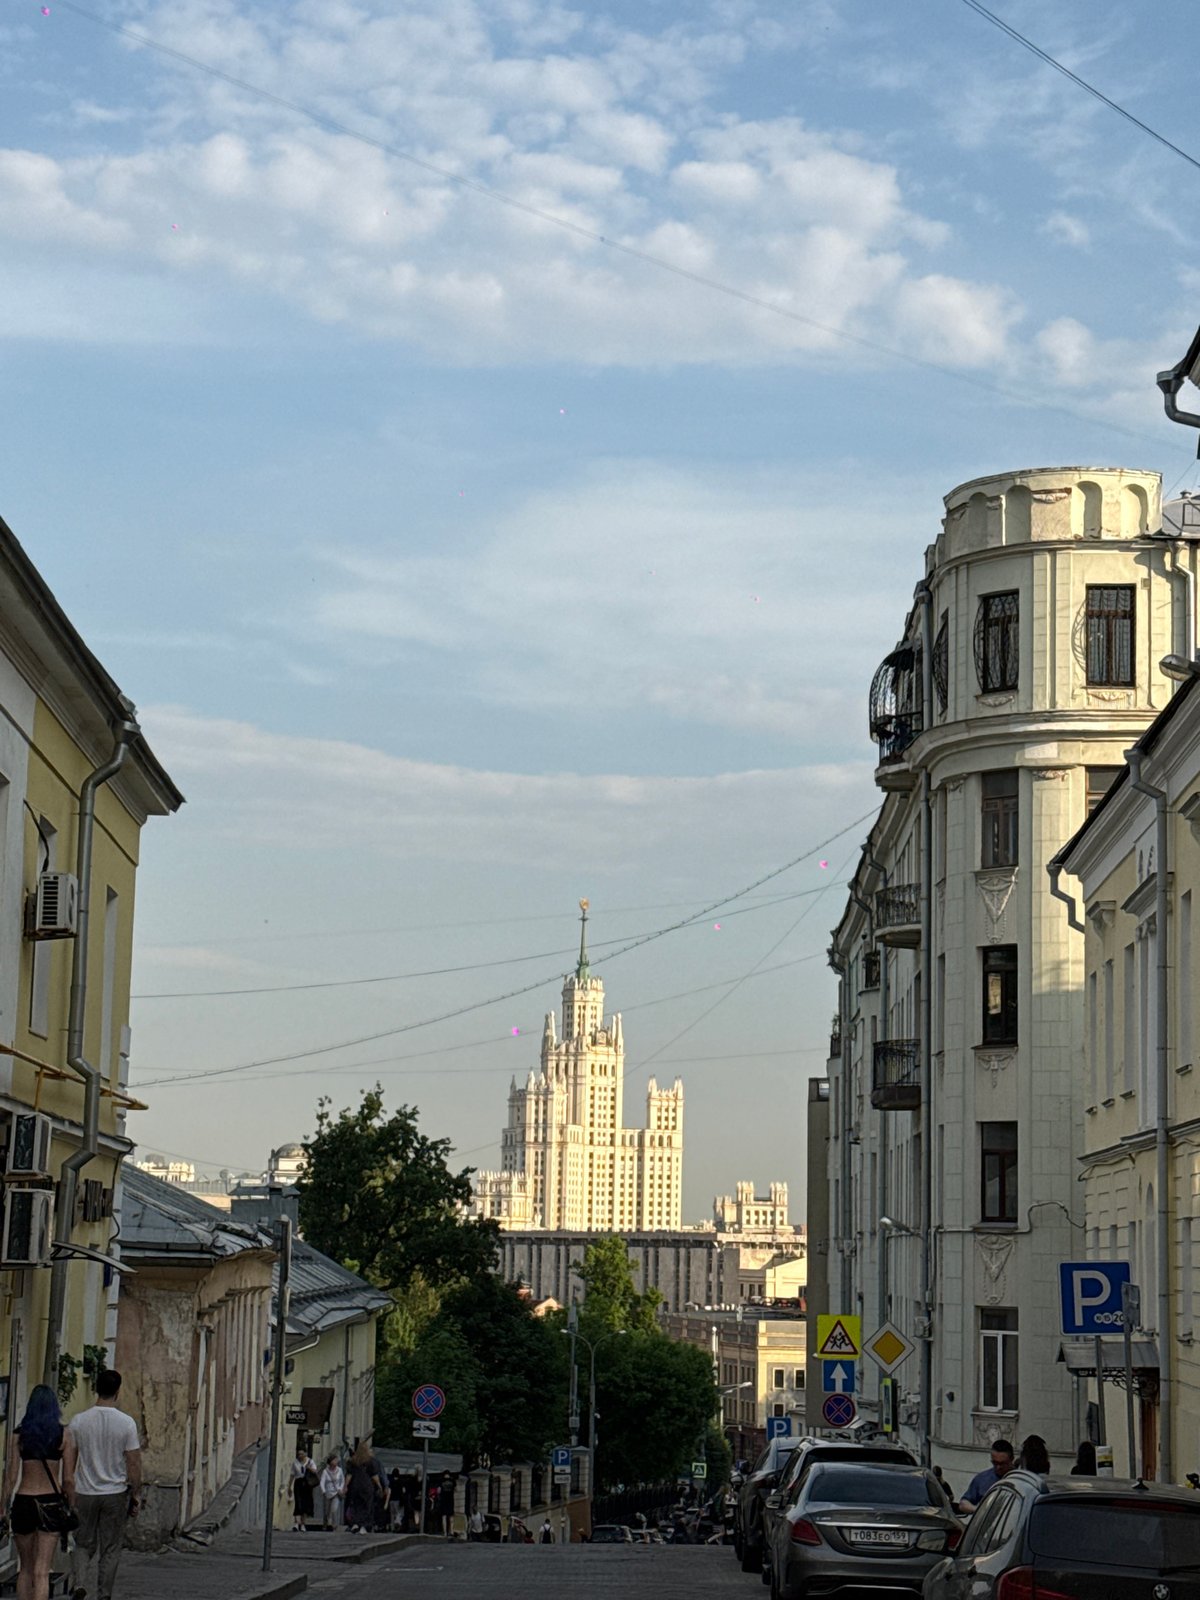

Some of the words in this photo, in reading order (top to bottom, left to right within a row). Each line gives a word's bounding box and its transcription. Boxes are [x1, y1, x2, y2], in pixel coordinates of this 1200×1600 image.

[1072, 1270, 1111, 1326] P
[773, 1420, 788, 1437] P
[558, 1450, 568, 1464] P
